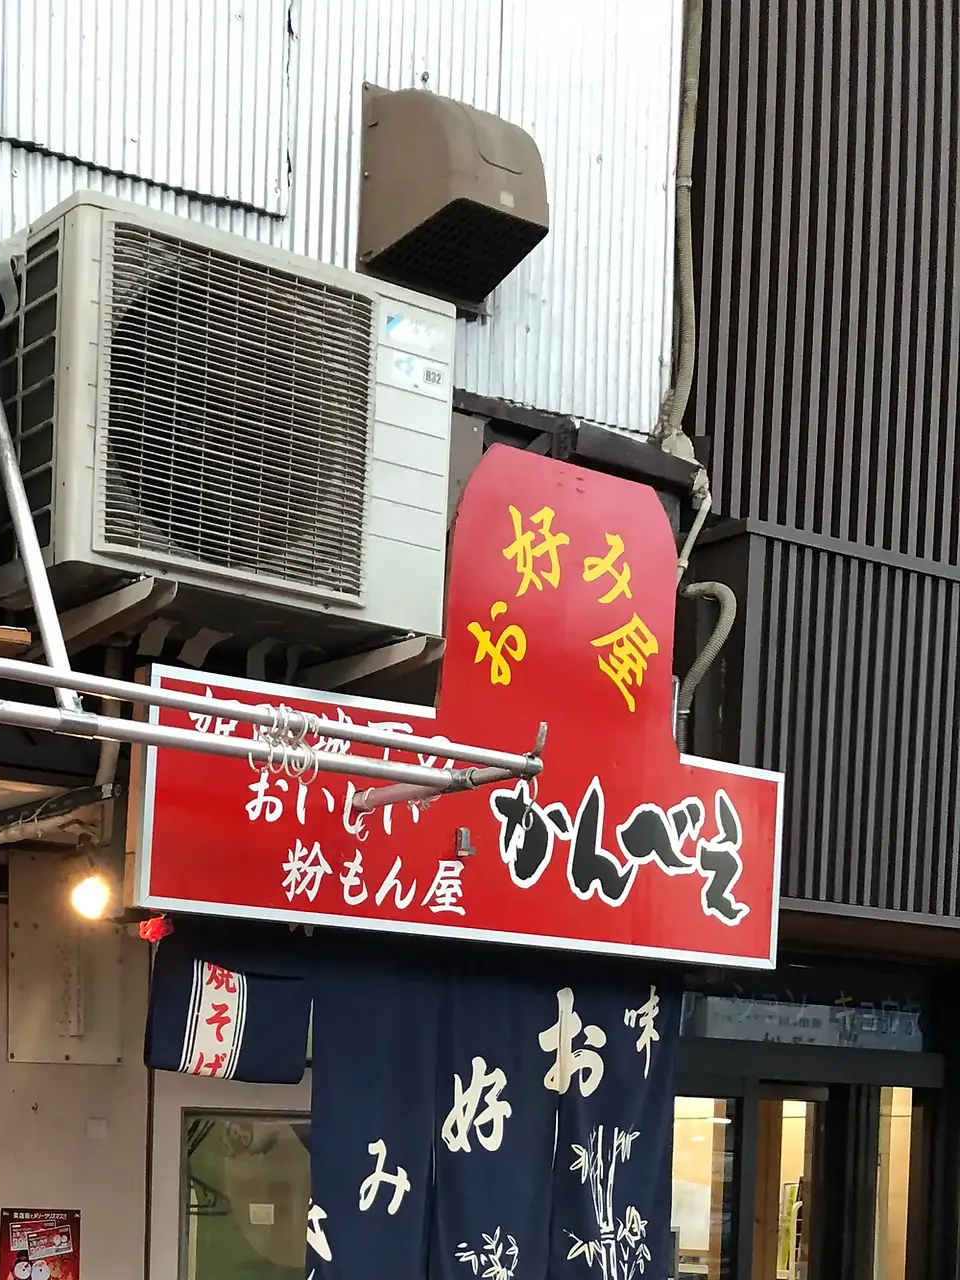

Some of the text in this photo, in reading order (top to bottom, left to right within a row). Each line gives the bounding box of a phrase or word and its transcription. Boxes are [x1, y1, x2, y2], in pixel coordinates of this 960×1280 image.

[425, 370, 441, 385] R32
[467, 505, 661, 712] お好み屋
[281, 838, 467, 917] 粉もん屋
[490, 775, 750, 927] かんべえ
[192, 961, 237, 1077] 焼そば
[624, 985, 662, 1079] 味
